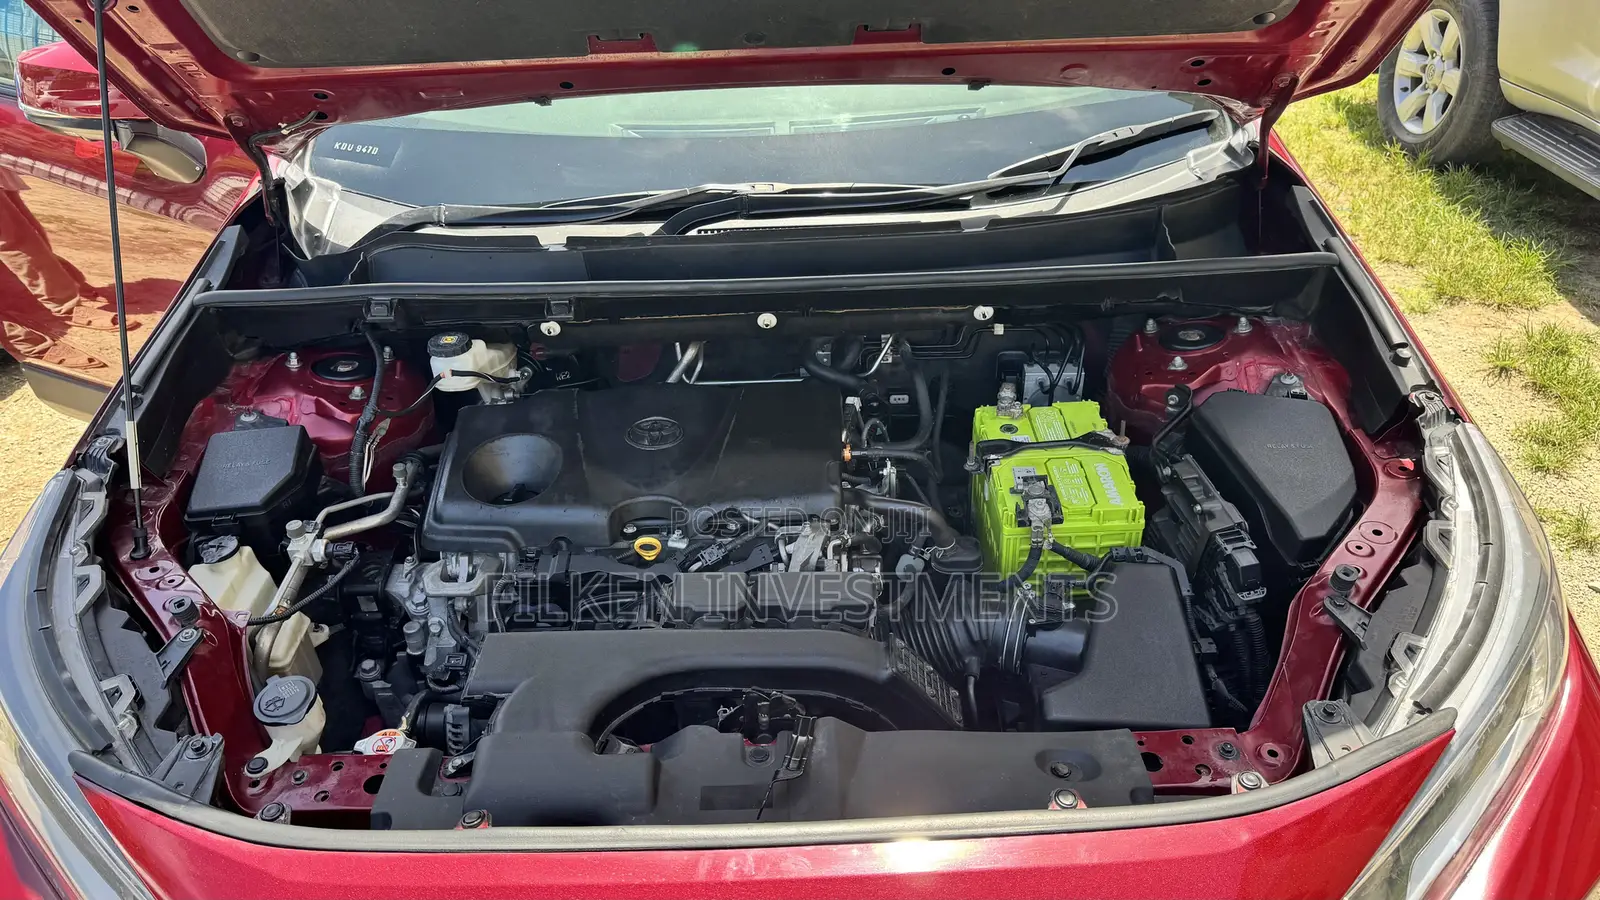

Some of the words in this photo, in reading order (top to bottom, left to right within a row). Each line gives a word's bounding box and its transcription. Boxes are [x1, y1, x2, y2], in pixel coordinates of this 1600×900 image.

[334, 142, 354, 151] KDU
[355, 145, 379, 155] 947D
[1093, 462, 1123, 506] AMARON
